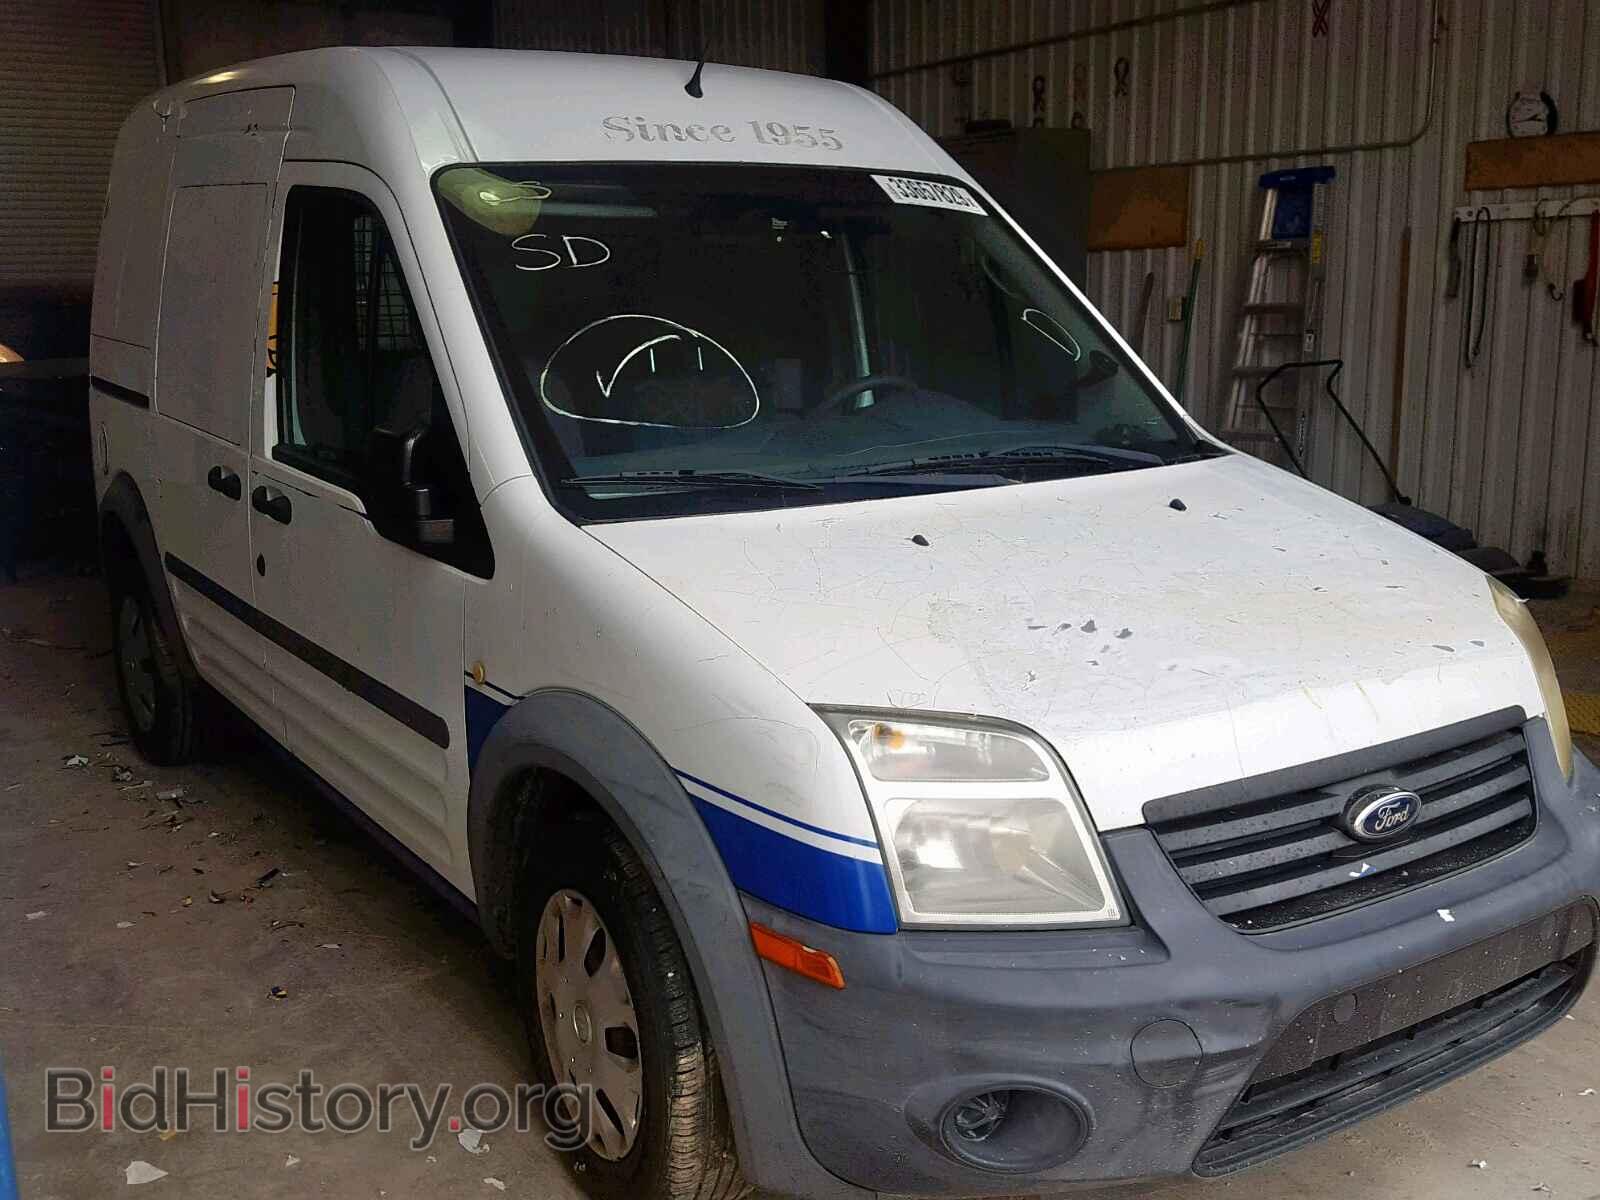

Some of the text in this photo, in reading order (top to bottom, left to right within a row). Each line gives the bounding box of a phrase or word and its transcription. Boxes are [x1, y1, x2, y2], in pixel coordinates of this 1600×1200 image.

[602, 115, 843, 151] Since 1955
[511, 233, 611, 270] SD
[1374, 802, 1411, 832] Ford
